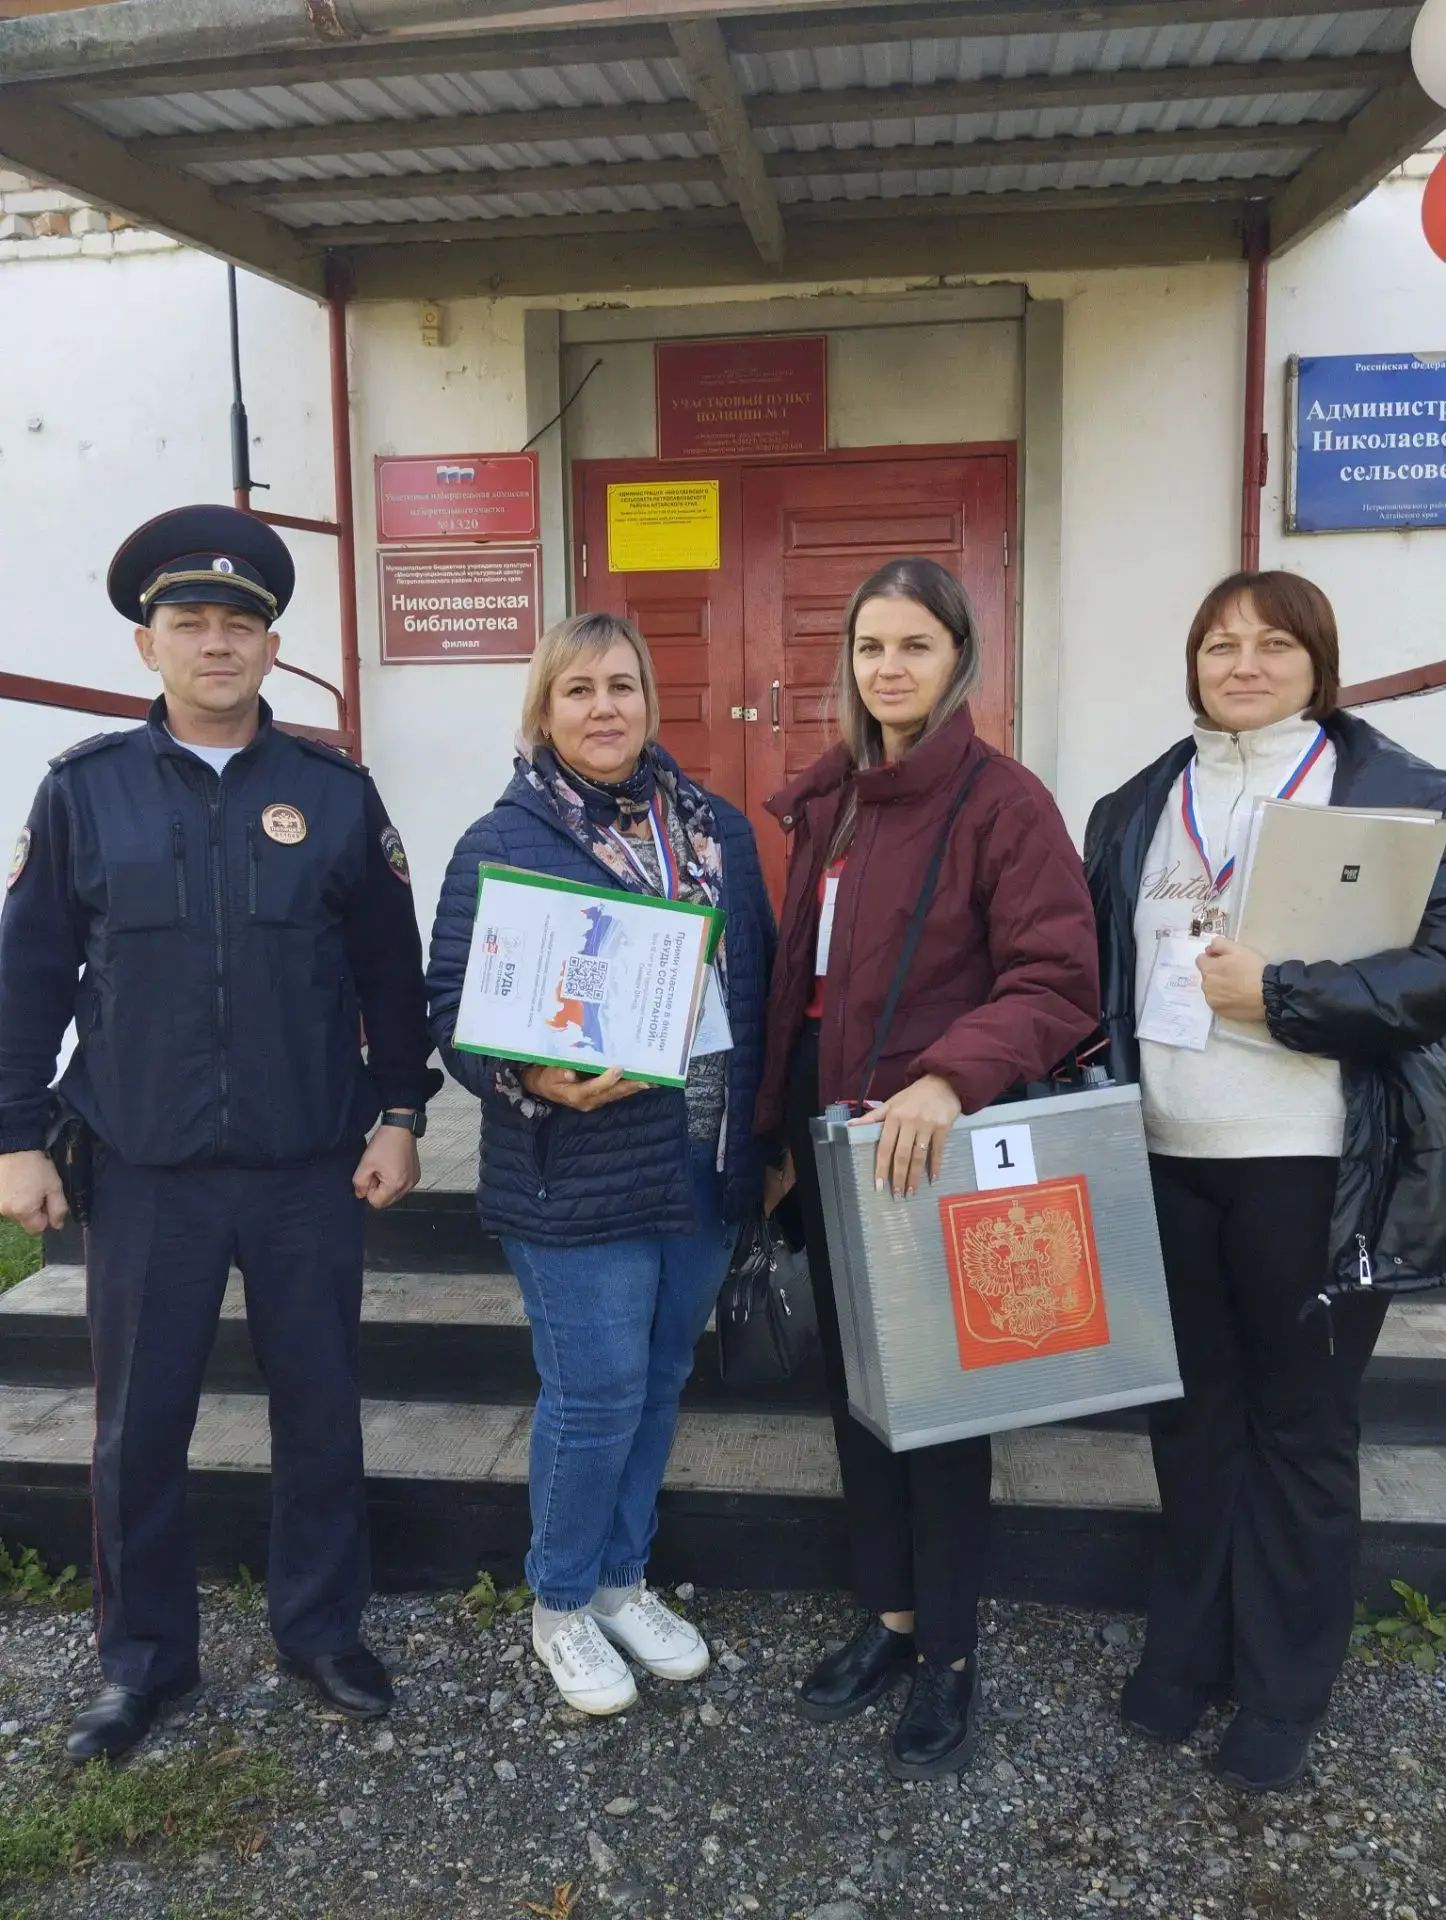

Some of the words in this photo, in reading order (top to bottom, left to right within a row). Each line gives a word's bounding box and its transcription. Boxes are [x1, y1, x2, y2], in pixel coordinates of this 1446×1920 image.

[1355, 362, 1409, 372] Российская
[672, 393, 763, 410] УЧАСТКОВЫЙ
[766, 391, 812, 406] ПУНКТ
[696, 408, 762, 423] ПОЛИЦИИ
[392, 594, 529, 611] Николаевская
[404, 615, 518, 632] библиотека
[441, 639, 480, 650] филиал
[1142, 860, 1231, 913] Vintag
[673, 931, 686, 966] Прими
[501, 962, 516, 997] БУДЬ
[656, 970, 667, 985] СО
[665, 968, 678, 1010] участие
[659, 1019, 670, 1051] акции
[995, 1139, 1015, 1169] 1
